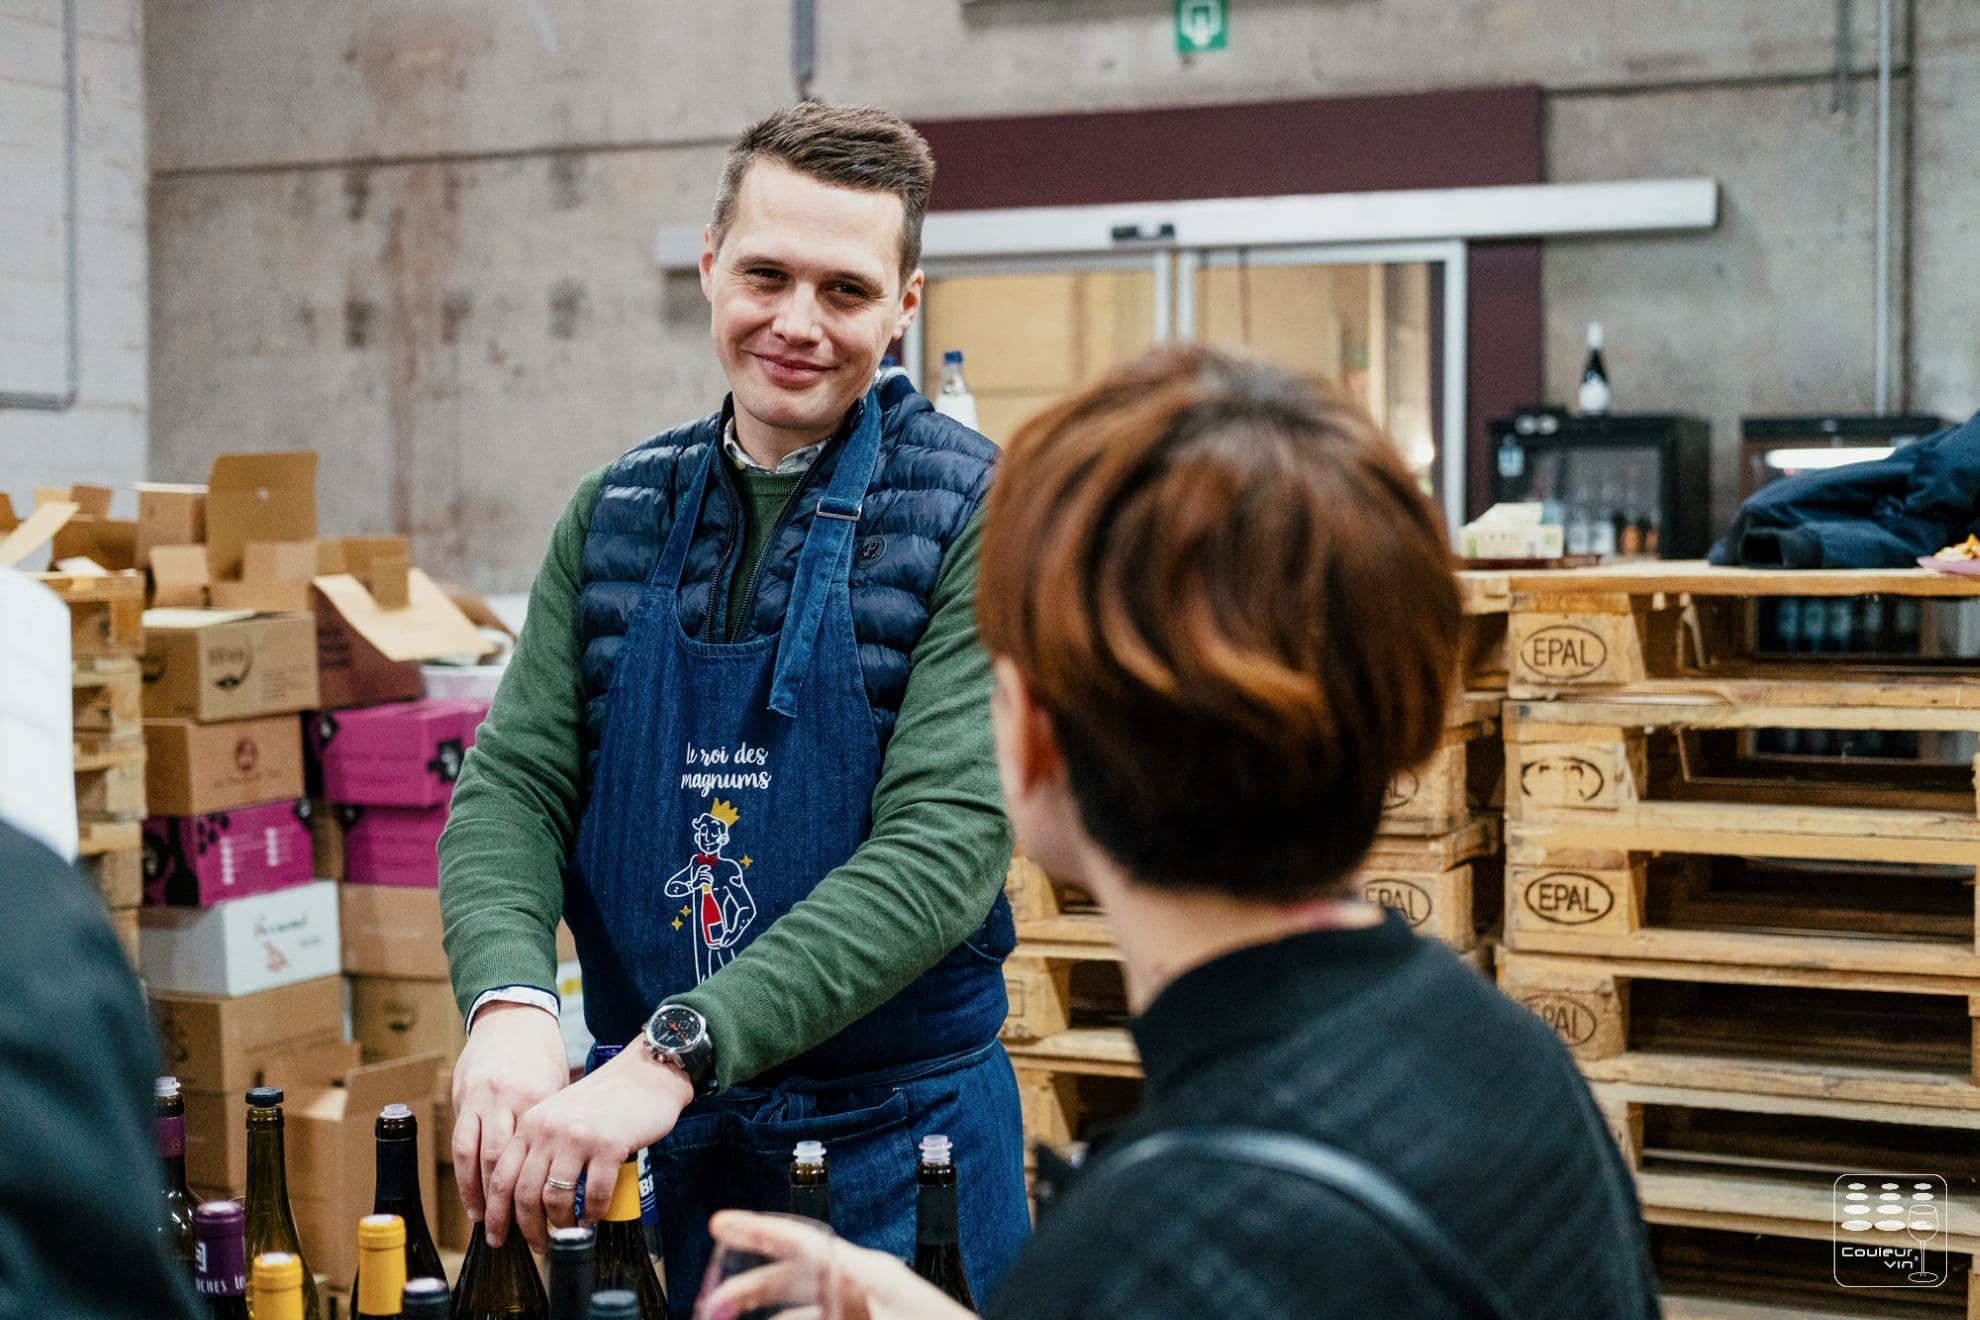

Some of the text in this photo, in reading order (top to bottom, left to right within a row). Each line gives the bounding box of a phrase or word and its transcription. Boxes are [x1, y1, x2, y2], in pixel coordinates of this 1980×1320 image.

[1533, 638, 1594, 668] EPAL
[700, 746, 729, 767] roi
[734, 741, 768, 766] des
[681, 771, 772, 798] magnums
[1538, 883, 1599, 914] EPAL
